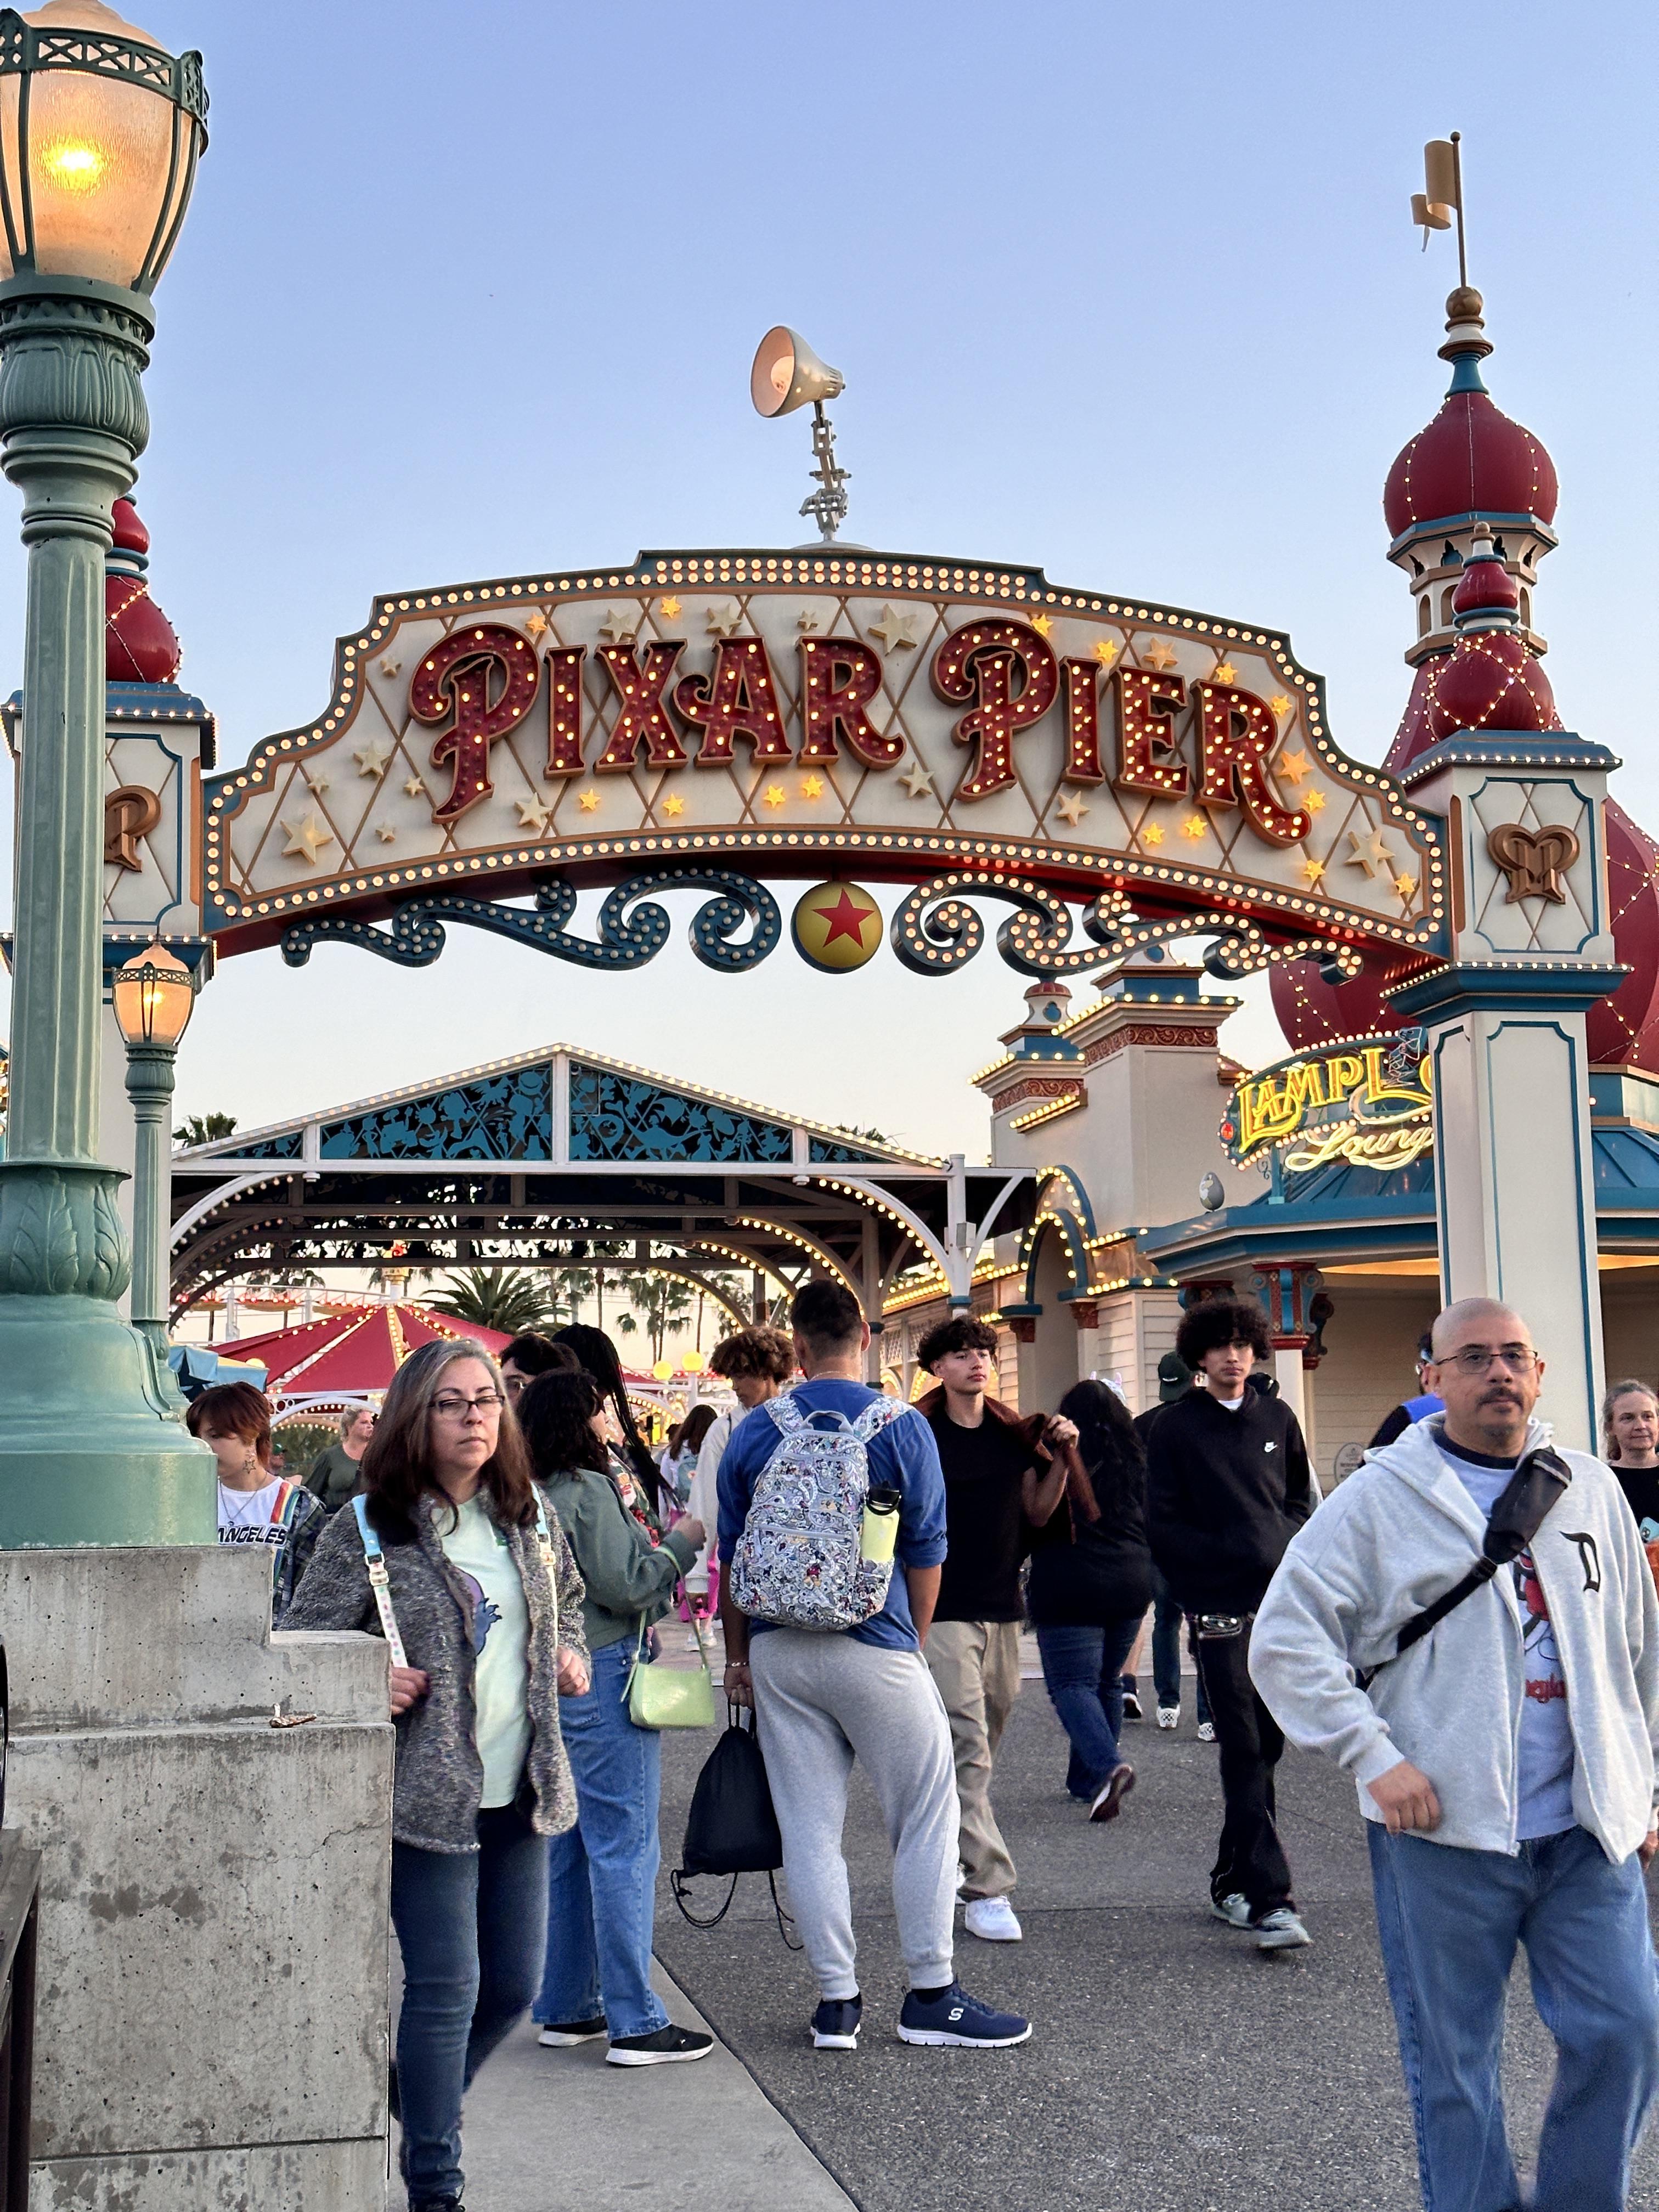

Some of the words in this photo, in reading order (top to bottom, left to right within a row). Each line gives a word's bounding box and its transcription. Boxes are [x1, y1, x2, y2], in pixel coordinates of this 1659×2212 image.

[408, 622, 906, 824] PIXAR
[929, 617, 1312, 849] PIER
[1284, 1126, 1435, 1172] Loung
